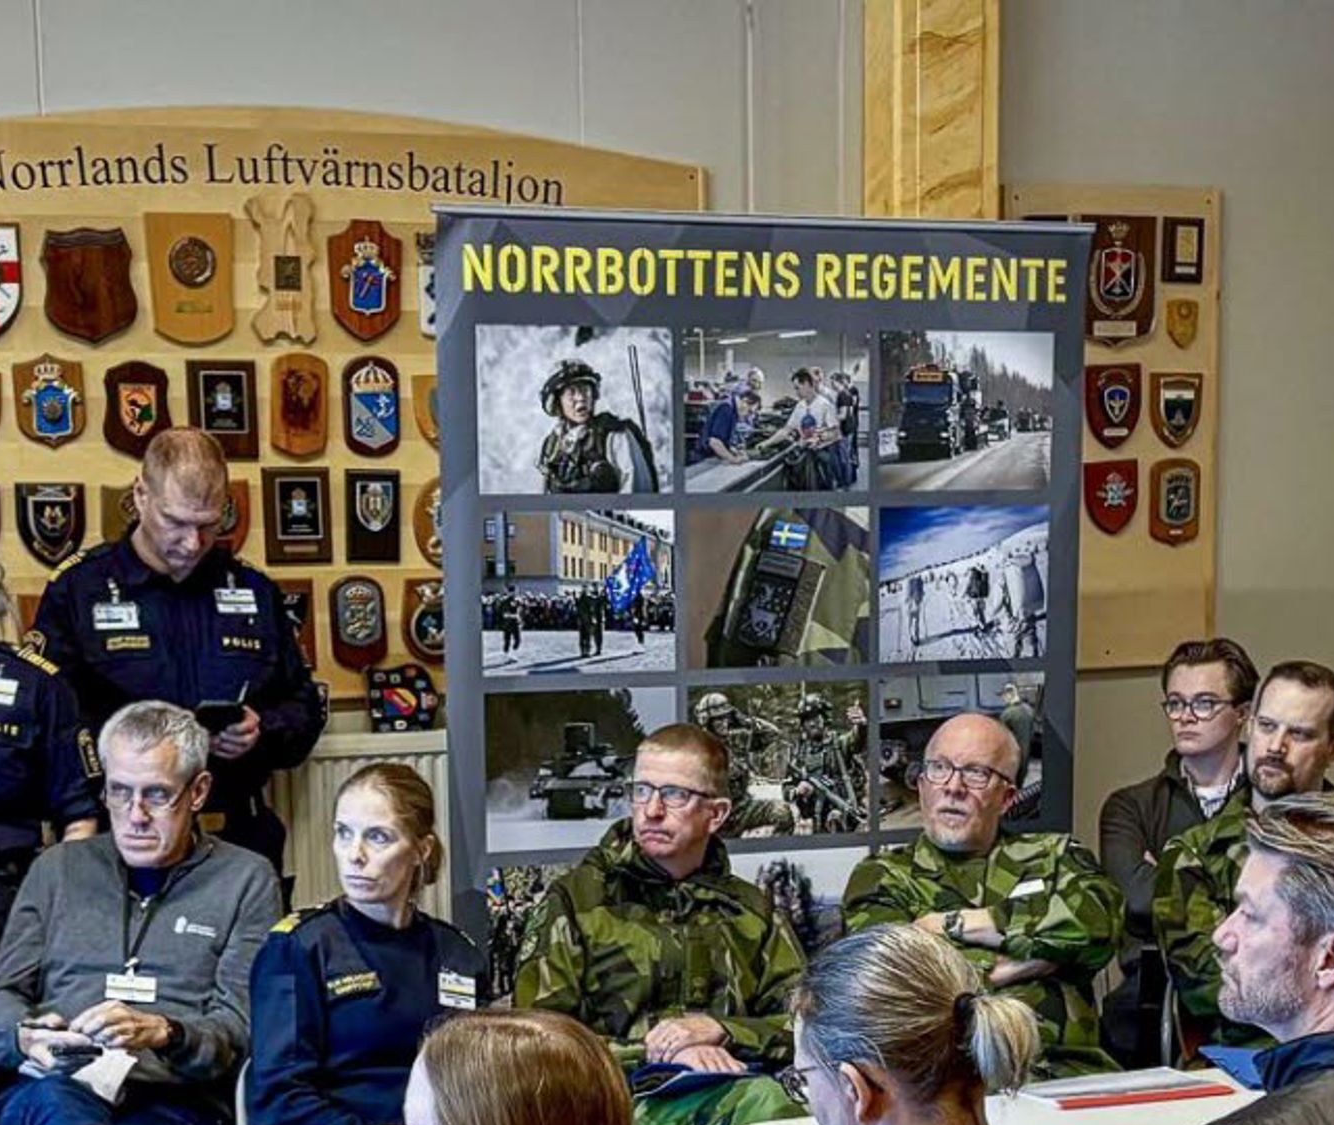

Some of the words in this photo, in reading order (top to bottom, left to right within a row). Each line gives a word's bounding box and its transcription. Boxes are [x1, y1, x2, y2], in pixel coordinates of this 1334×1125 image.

[204, 143, 565, 207] Luftvärnsbataljon
[462, 244, 801, 298] NORRBOTTENS
[816, 253, 1067, 302] REGEMENTE
[222, 636, 261, 650] POLIS
